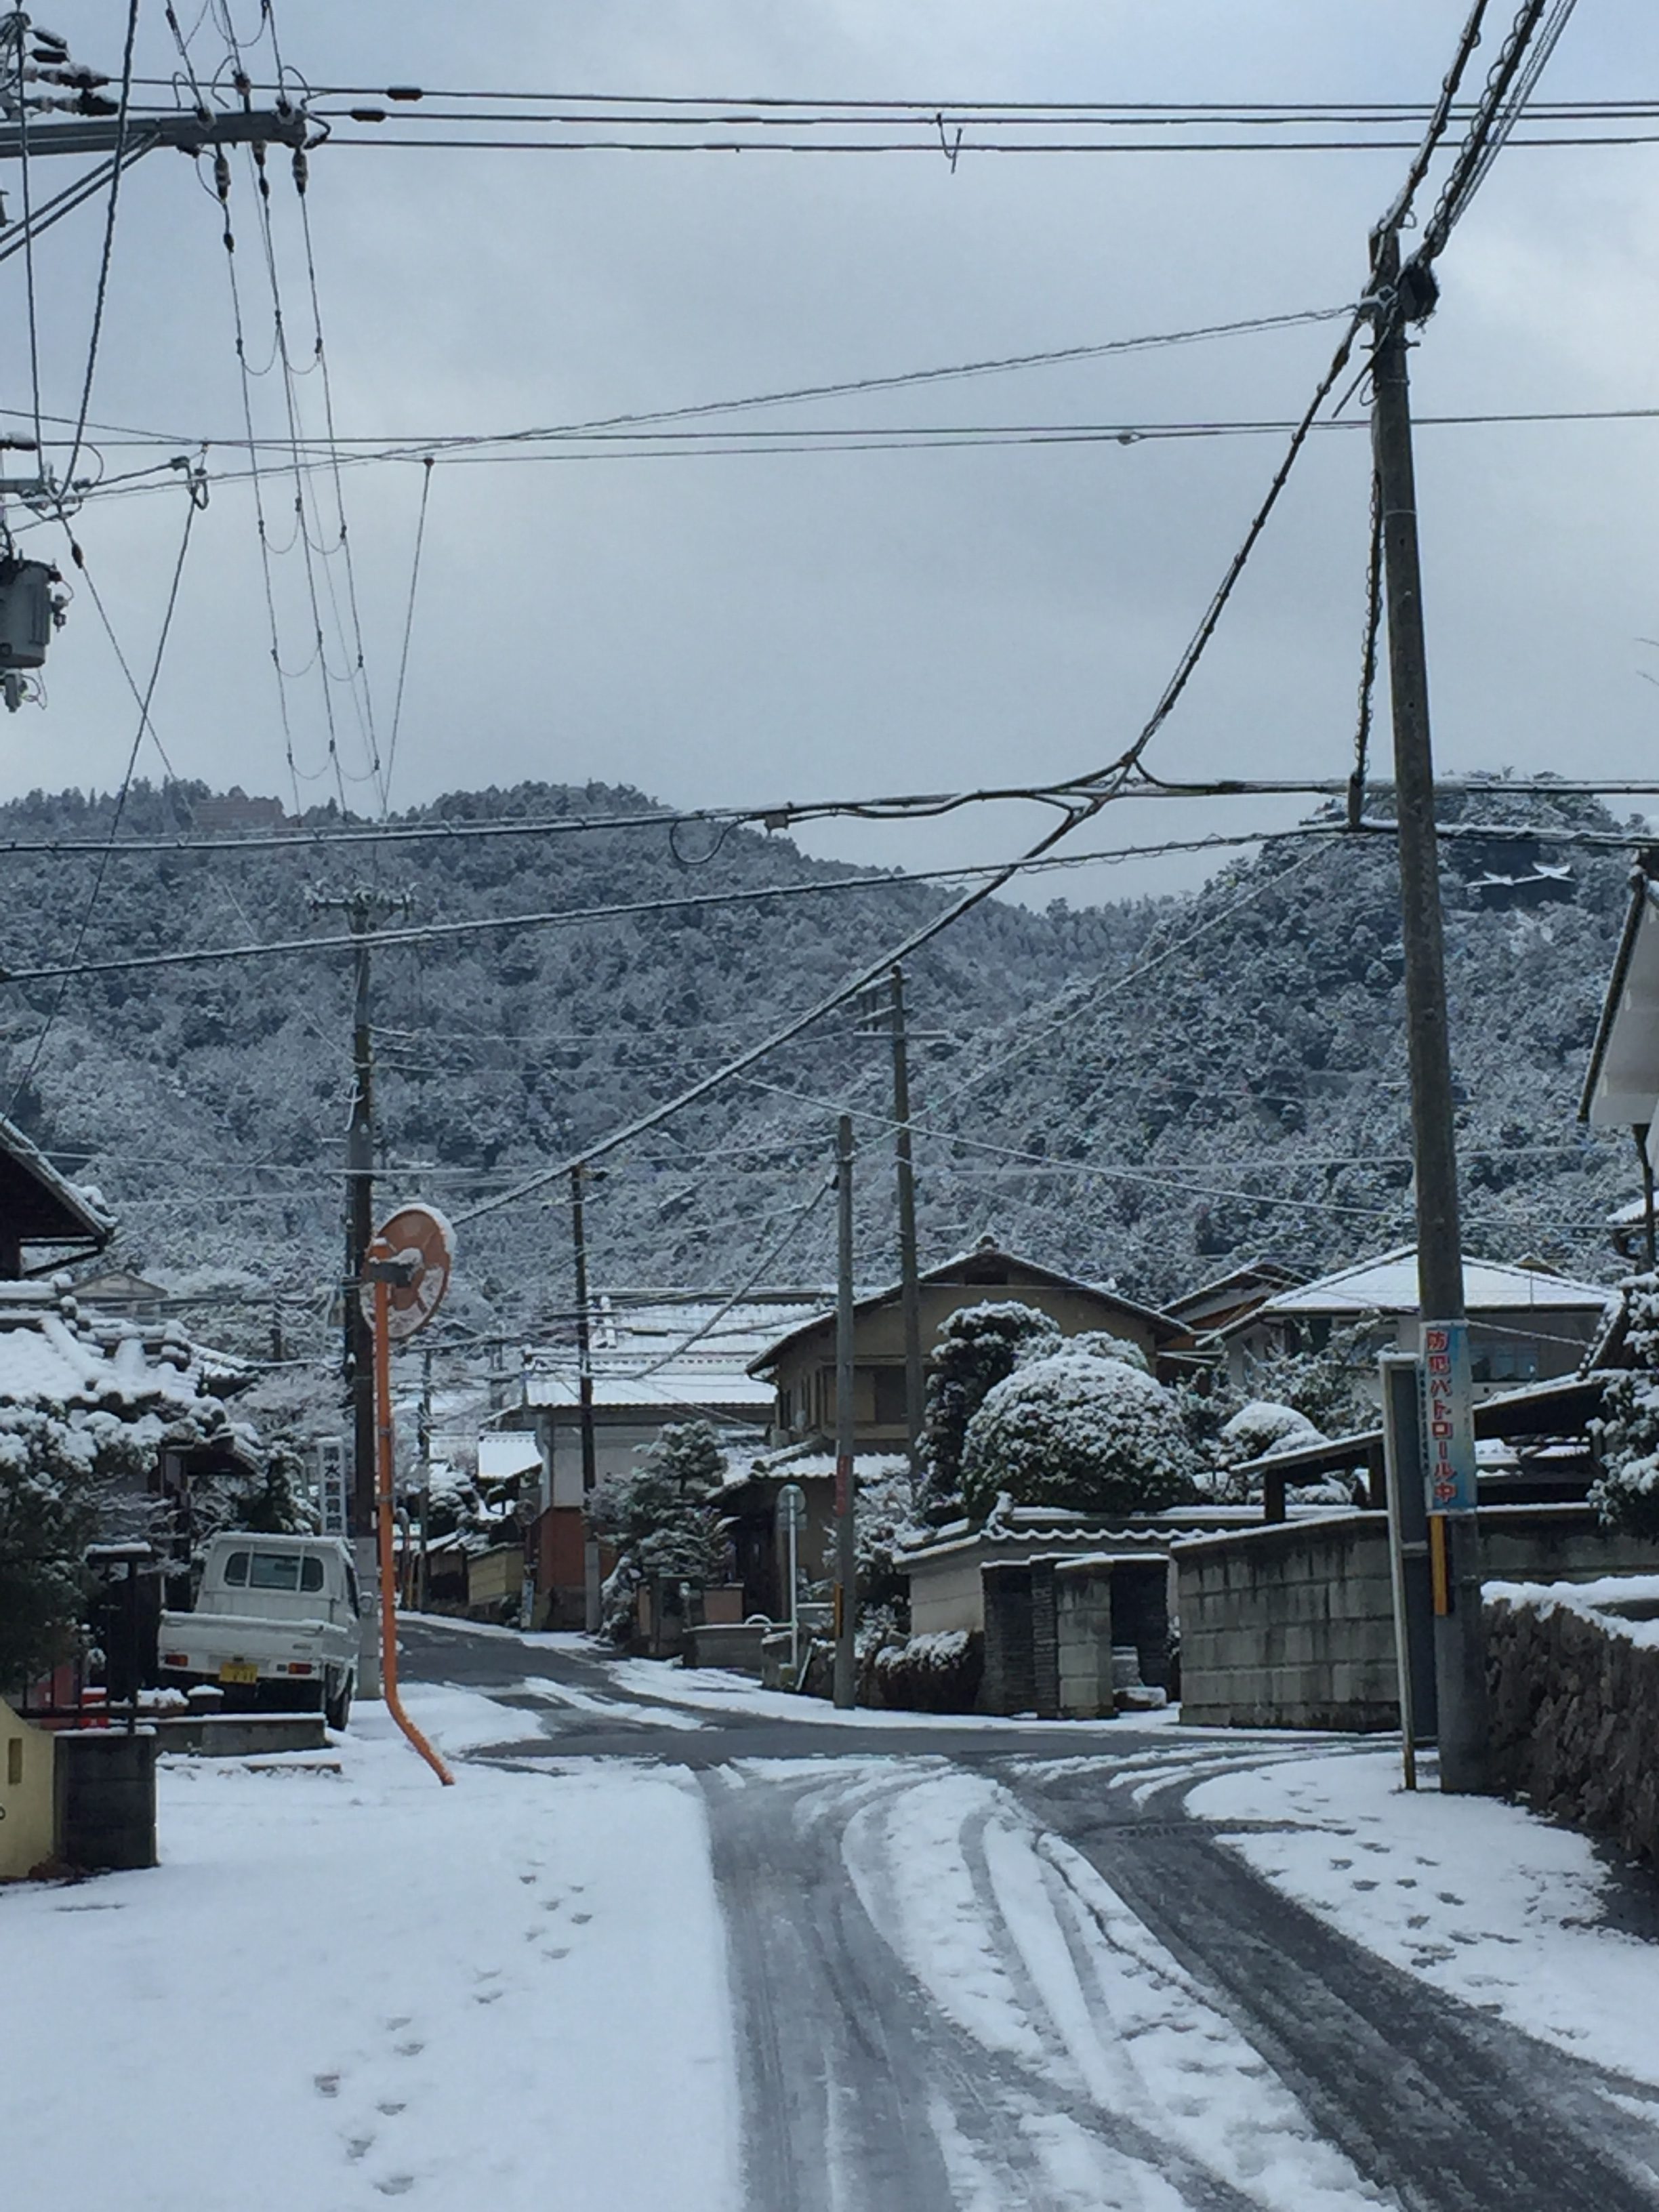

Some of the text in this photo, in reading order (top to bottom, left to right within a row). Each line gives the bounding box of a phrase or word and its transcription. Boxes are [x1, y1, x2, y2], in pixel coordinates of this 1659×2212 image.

[1426, 1330, 1457, 1503] 防犯パトロール中
